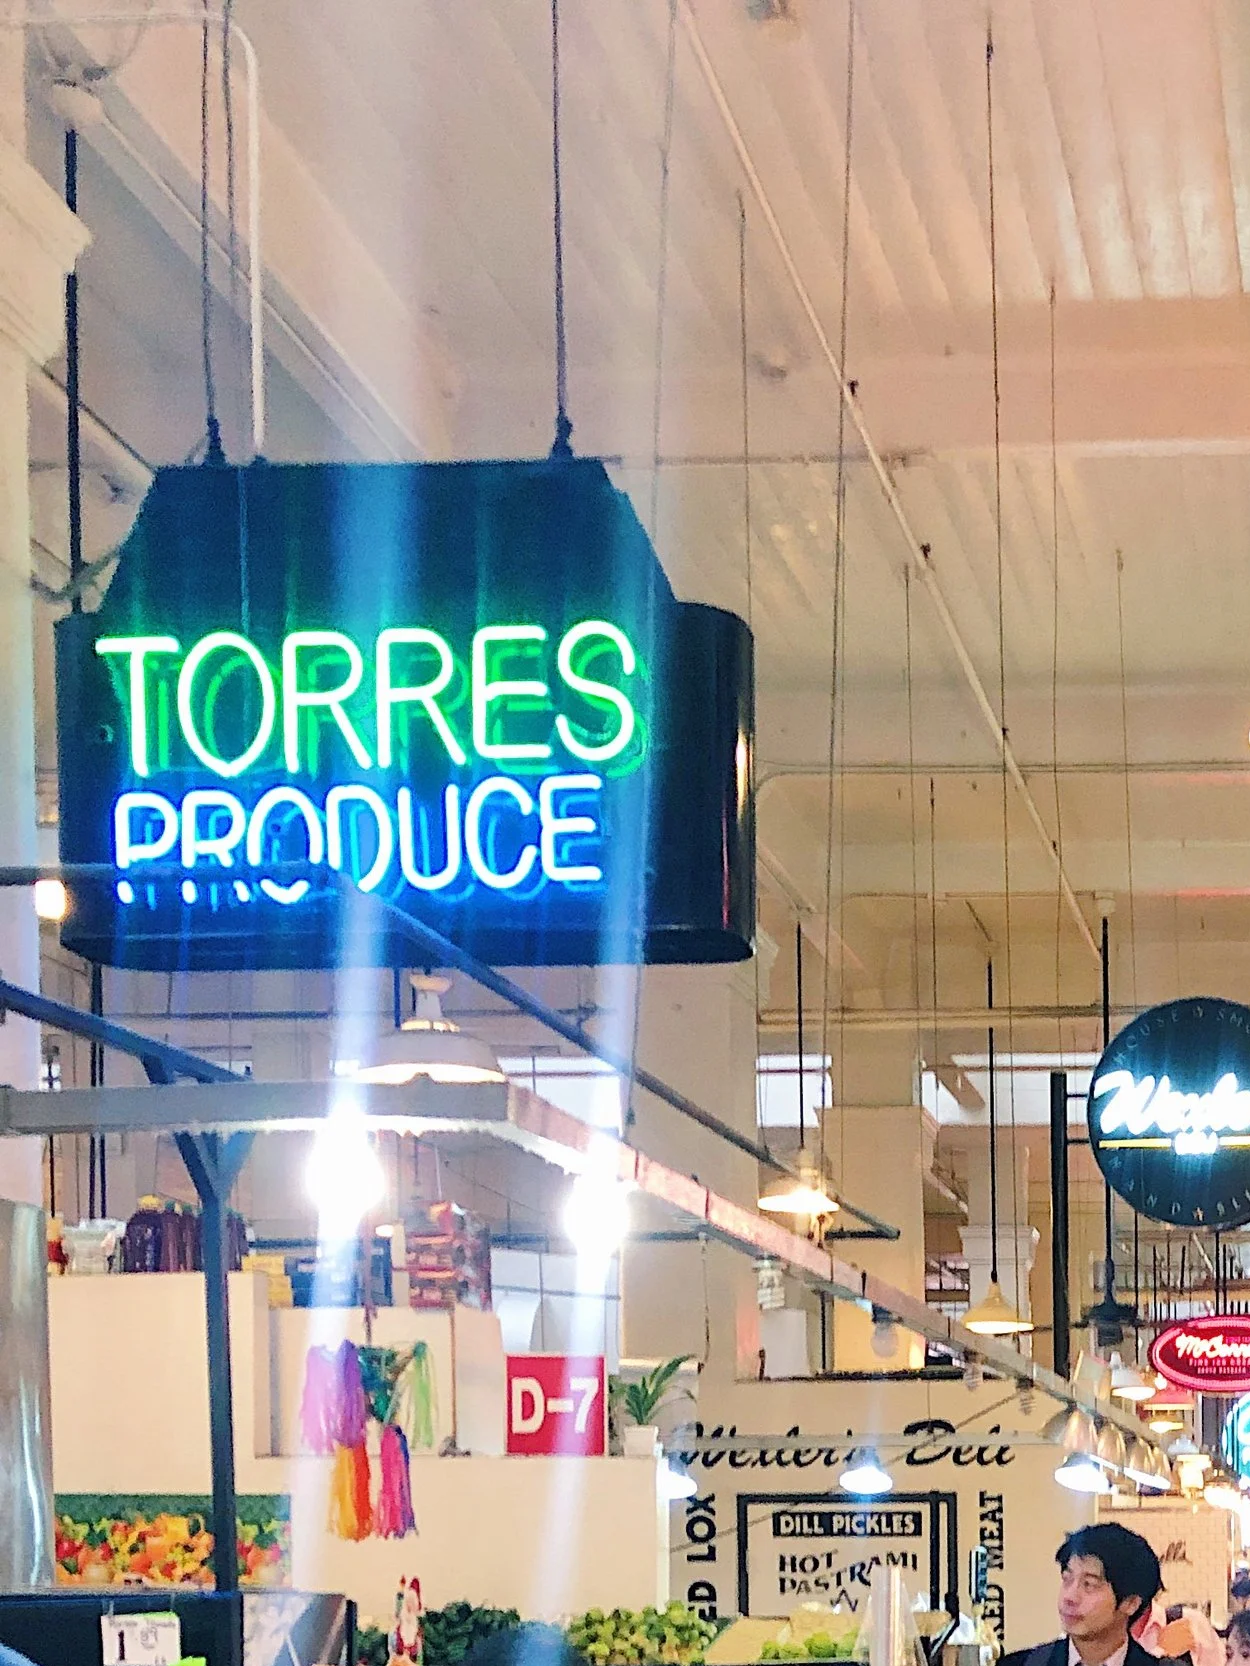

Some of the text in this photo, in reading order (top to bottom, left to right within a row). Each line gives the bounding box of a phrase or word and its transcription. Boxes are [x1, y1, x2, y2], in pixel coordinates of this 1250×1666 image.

[96, 620, 636, 778] TORRES
[115, 774, 602, 904] PRODUCE
[510, 1376, 600, 1434] D-7
[903, 1419, 1016, 1466] Deli
[685, 1493, 717, 1562] LOX
[780, 1513, 916, 1535] DILL PICKLES
[979, 1490, 1004, 1570] MEAT
[779, 1549, 838, 1574] HOT
[779, 1551, 918, 1595] PASTRAMI
